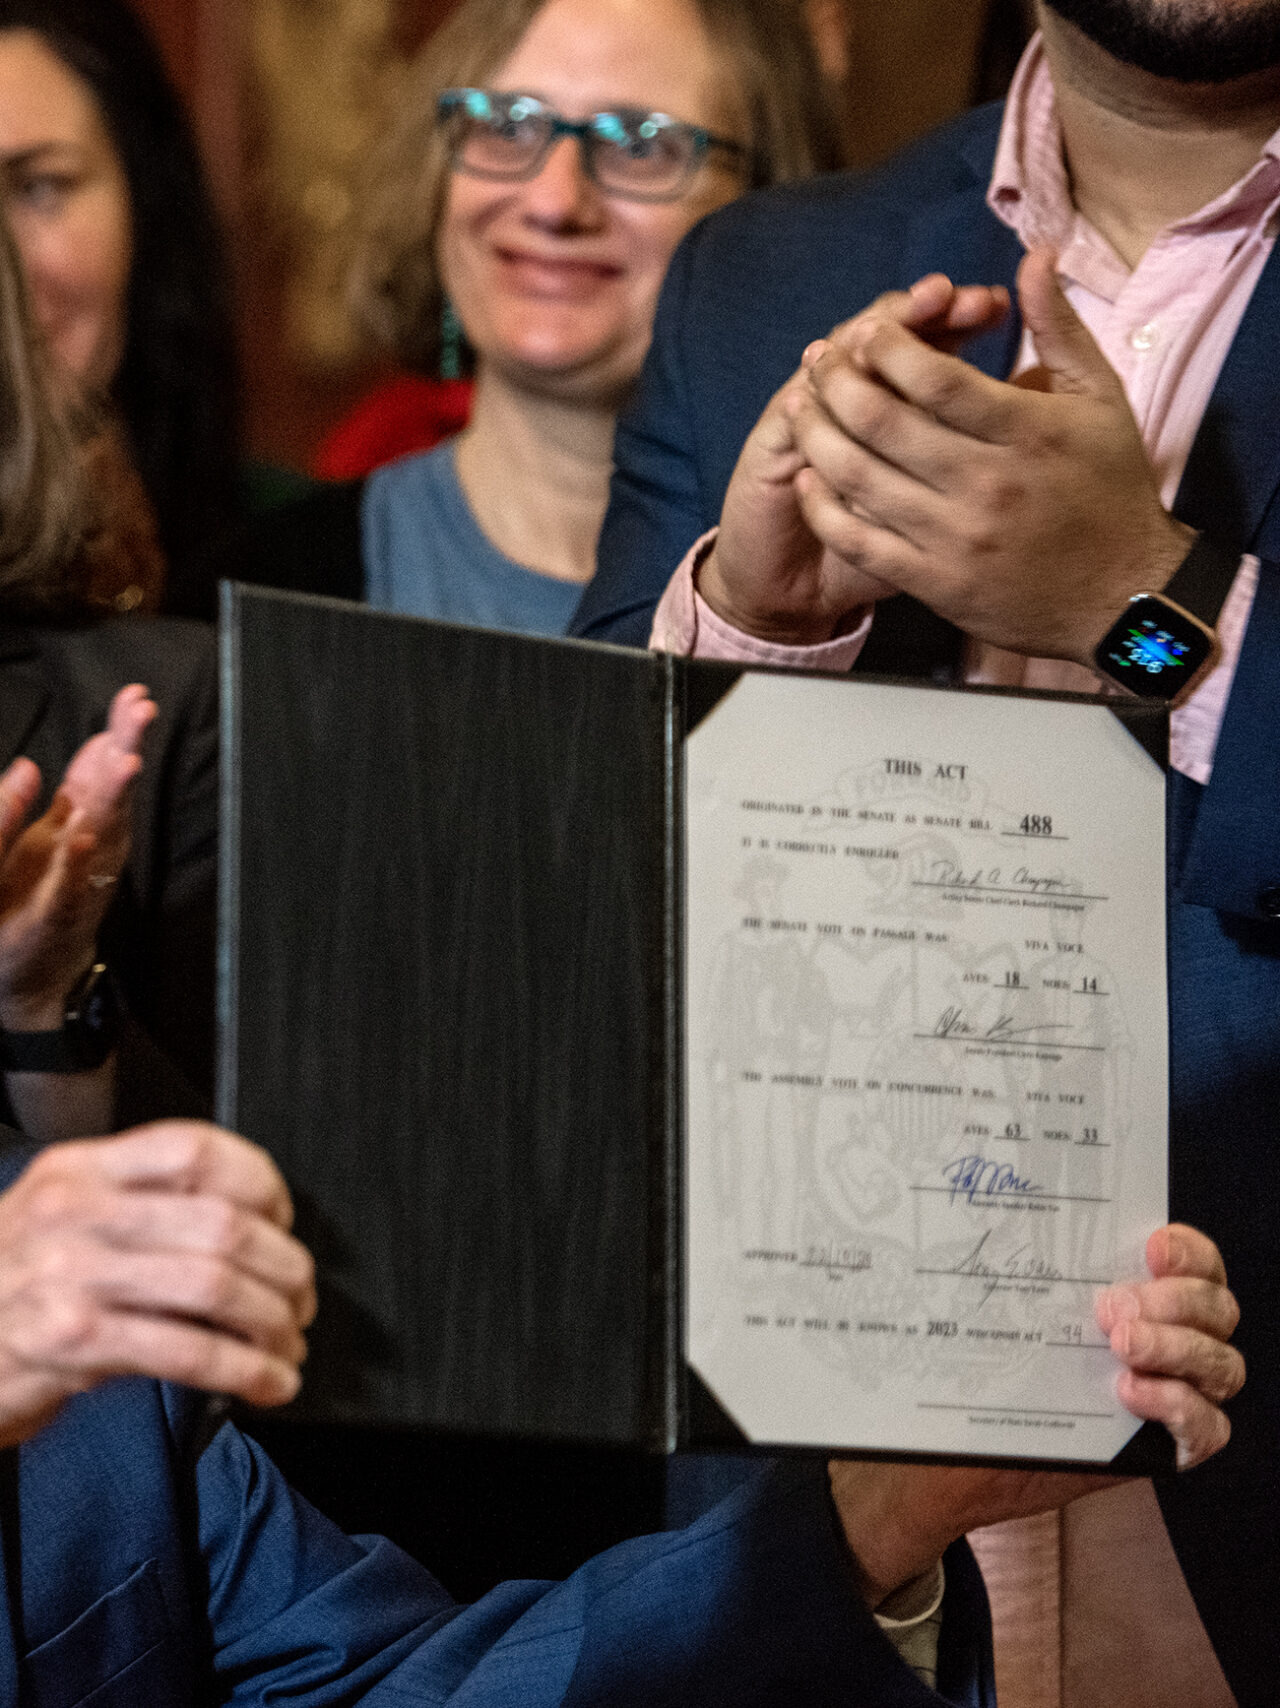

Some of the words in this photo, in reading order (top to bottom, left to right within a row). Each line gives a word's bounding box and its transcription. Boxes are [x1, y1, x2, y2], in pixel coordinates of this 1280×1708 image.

[884, 758, 922, 776] THIS
[934, 764, 968, 780] ACT
[741, 799, 804, 815] ORIGINATED
[831, 806, 850, 818] THE
[858, 809, 896, 823] SENATE
[904, 814, 917, 824] AS
[923, 815, 962, 828] SENATE
[1019, 813, 1053, 835] 488
[776, 839, 837, 855] CORRECTLY
[817, 922, 842, 935] VOTE
[1024, 939, 1049, 951] VIVA
[1056, 941, 1085, 954] VOCE
[1005, 971, 1020, 987] 18
[1082, 976, 1098, 992] 14
[887, 1081, 963, 1096] CONCURRENCE
[1004, 1123, 1021, 1139] 63
[1082, 1126, 1098, 1144] 33
[927, 1320, 958, 1337] 2023
